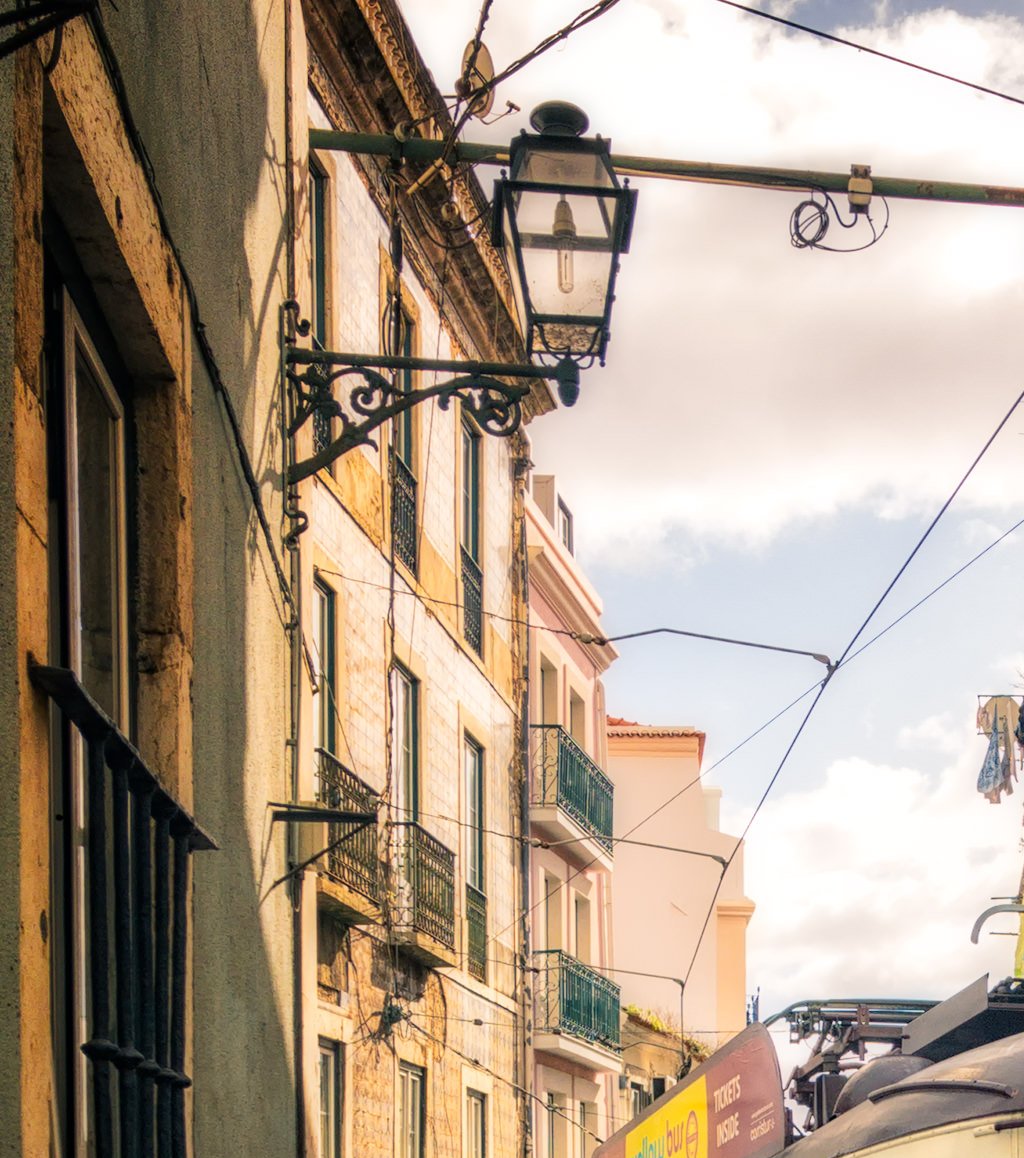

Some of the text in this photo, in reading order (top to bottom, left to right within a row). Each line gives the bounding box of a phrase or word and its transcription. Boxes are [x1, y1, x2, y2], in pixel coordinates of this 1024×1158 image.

[713, 1073, 742, 1114] TICKETS
[666, 1118, 685, 1158] bus
[716, 1111, 740, 1148] INSIDE
